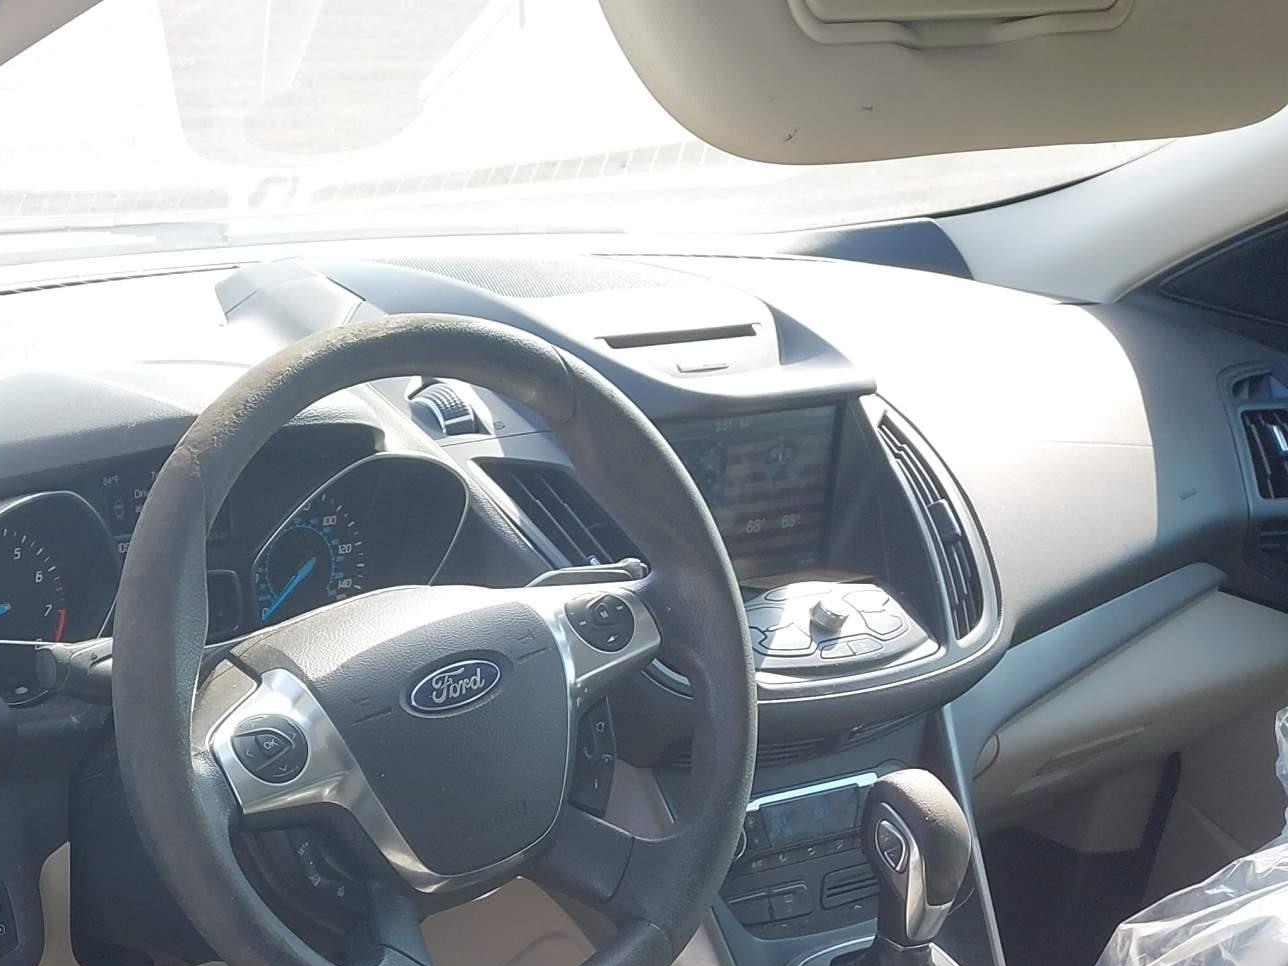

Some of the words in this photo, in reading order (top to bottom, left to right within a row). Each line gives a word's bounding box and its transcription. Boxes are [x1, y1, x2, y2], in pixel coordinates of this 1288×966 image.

[13, 547, 21, 560] 5
[337, 543, 352, 554] 120
[35, 570, 44, 583] 6
[337, 578, 352, 589] 140
[44, 604, 53, 617] 7
[432, 667, 485, 704] Ford
[263, 738, 278, 750] OK
